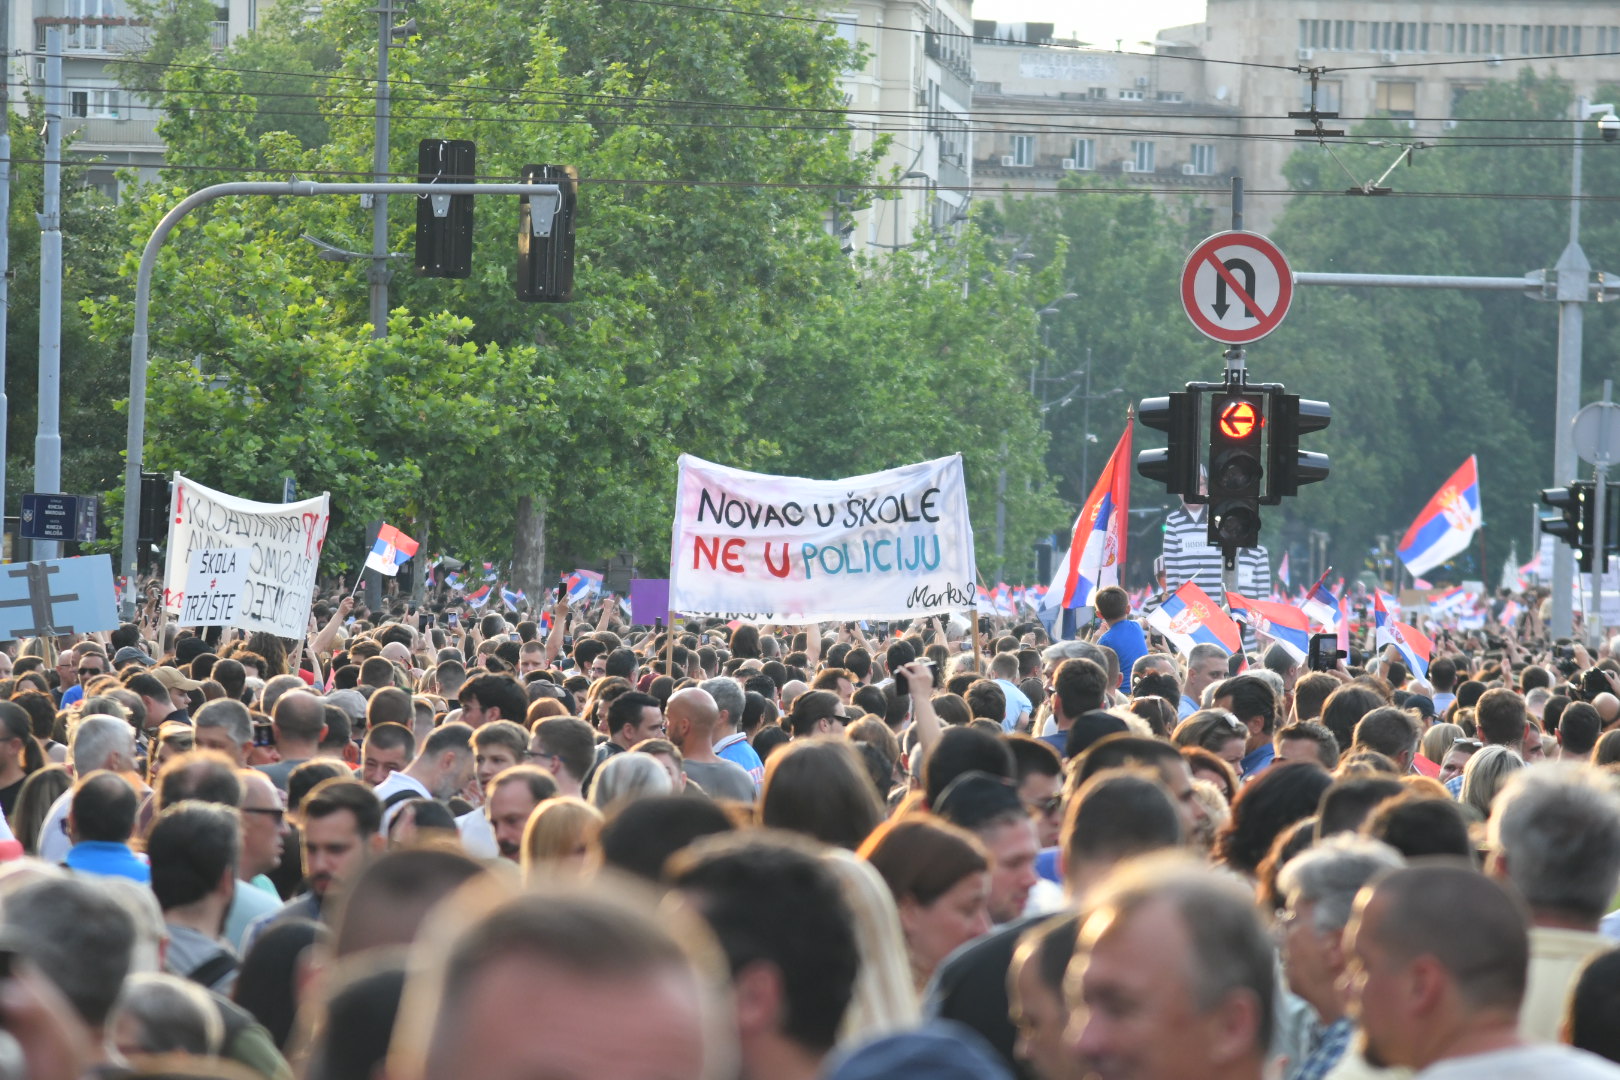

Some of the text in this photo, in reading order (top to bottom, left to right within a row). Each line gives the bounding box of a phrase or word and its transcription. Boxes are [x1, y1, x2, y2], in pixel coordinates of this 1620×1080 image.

[697, 488, 940, 529] NOVAC U ŠKOLE
[200, 550, 236, 574] ŠKOLA
[693, 534, 941, 580] NE U POLICIJU
[184, 590, 236, 622] TRŽIŠTE
